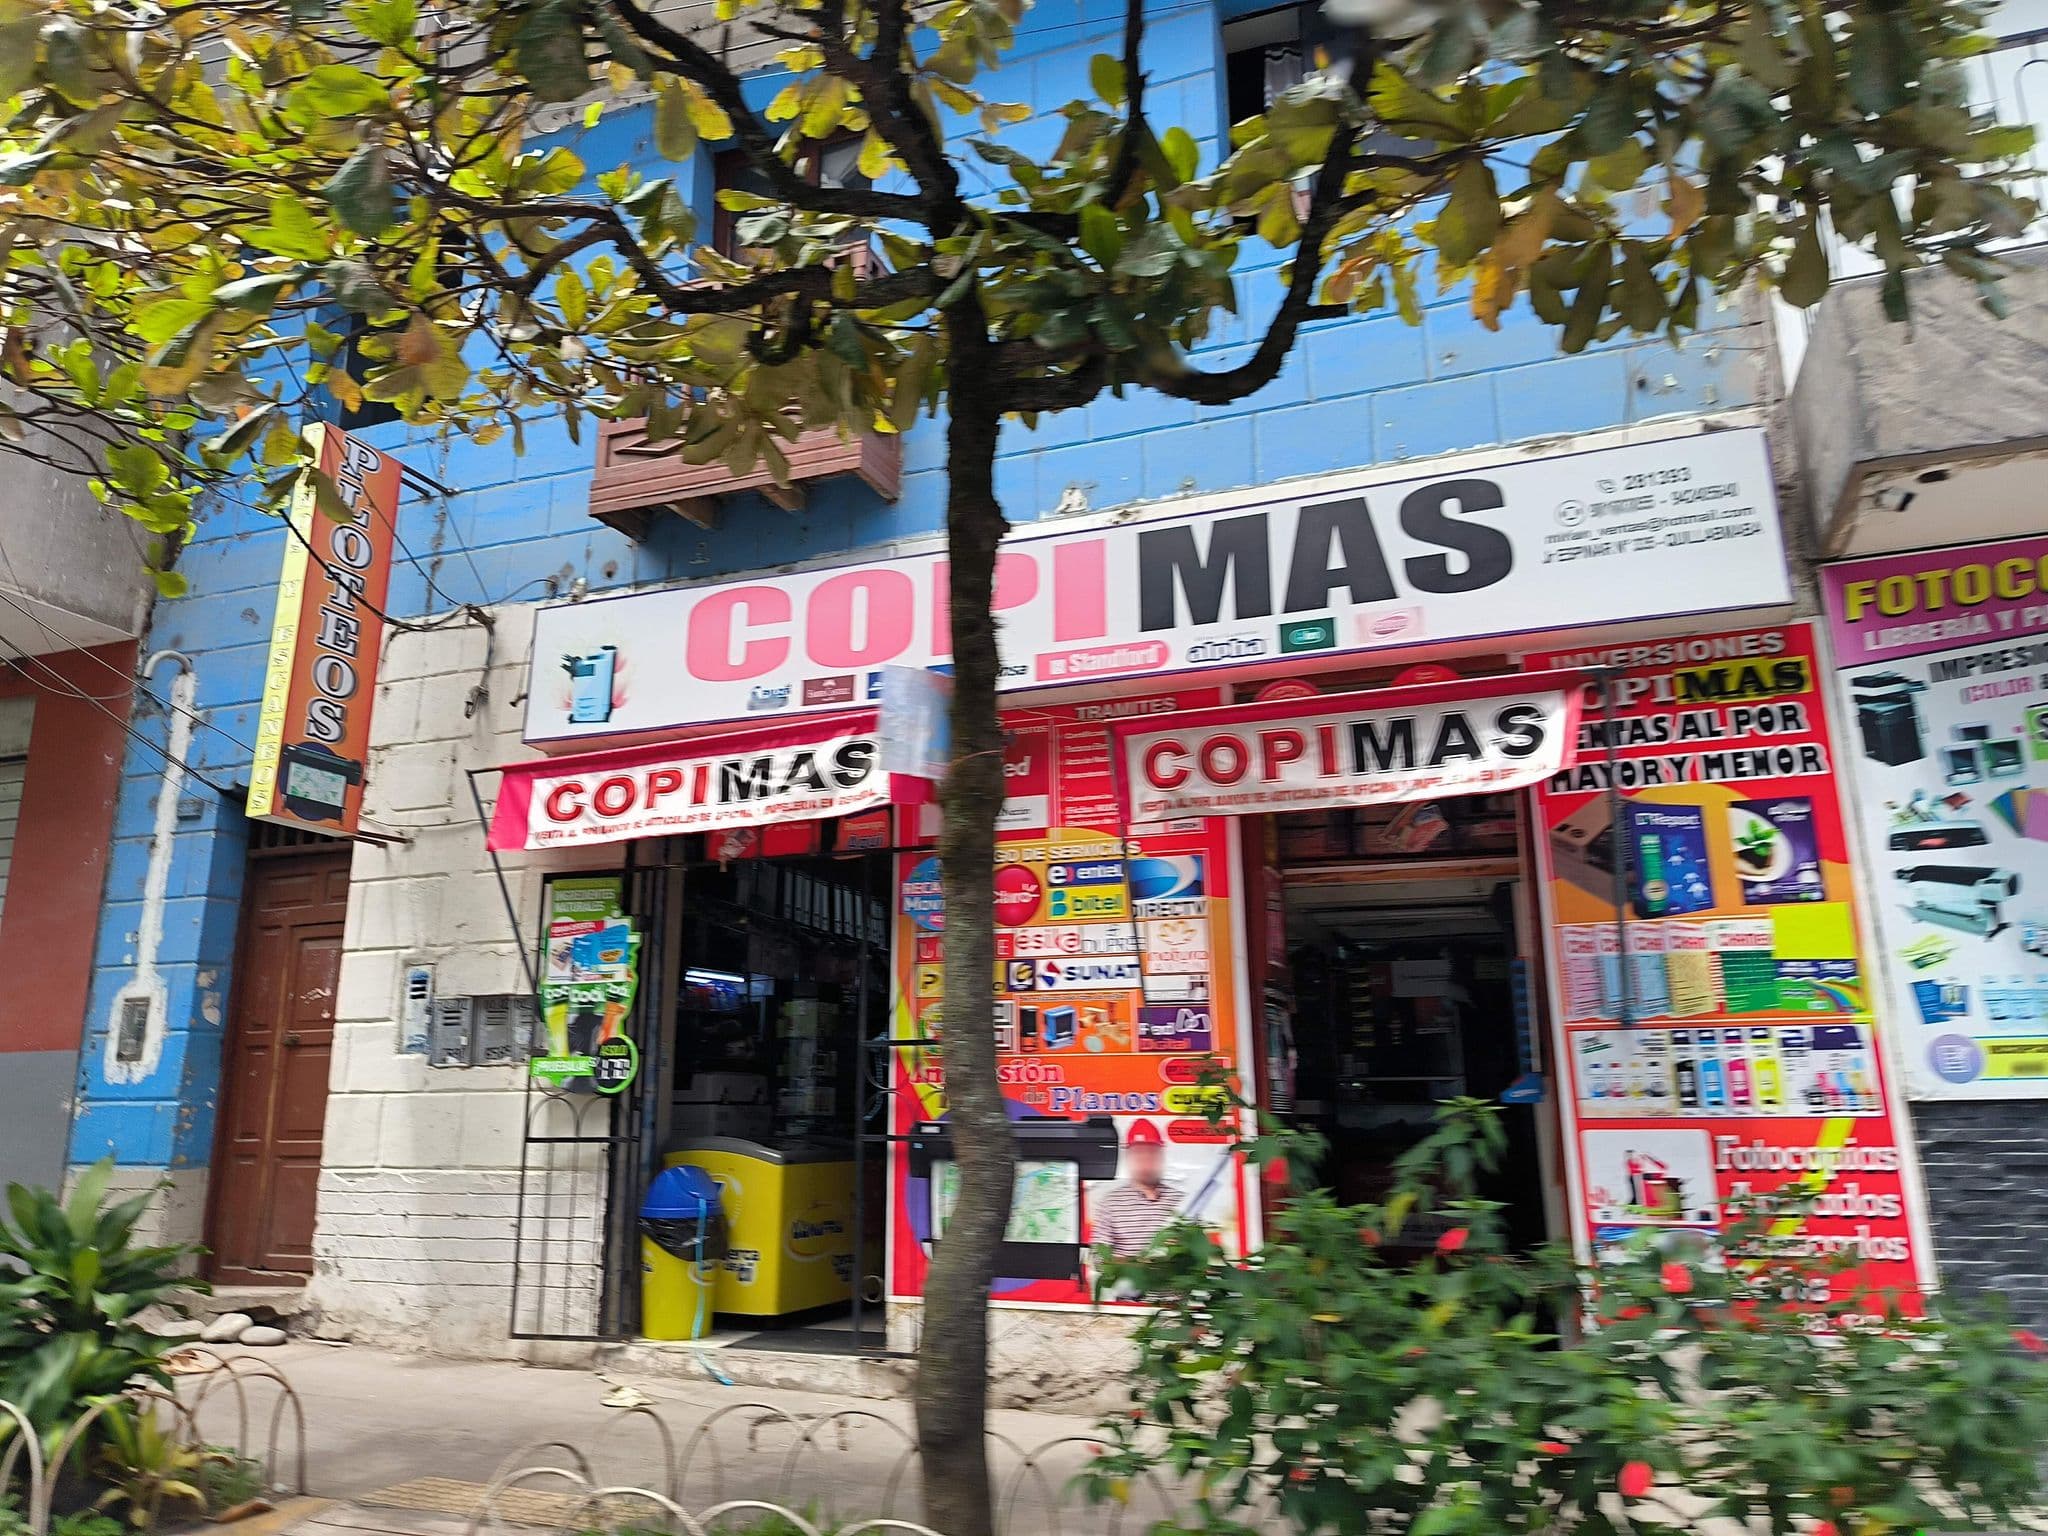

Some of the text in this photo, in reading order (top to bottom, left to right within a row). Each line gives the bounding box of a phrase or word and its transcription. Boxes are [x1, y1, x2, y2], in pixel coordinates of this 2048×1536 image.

[1187, 637, 1267, 664] alpha
[1579, 660, 1807, 710] OPIMAS
[1075, 698, 1178, 719] TRAMITES
[1681, 709, 1726, 741] AL
[1735, 704, 1808, 735] POR
[1144, 703, 1547, 791] COPIMAS
[1704, 745, 1824, 775] MENOR
[545, 741, 879, 822] COPIMAS
[1064, 963, 1140, 981] SUNAT
[1049, 1085, 1161, 1112] Planos
[1714, 1134, 1900, 1179] Fotocopias
